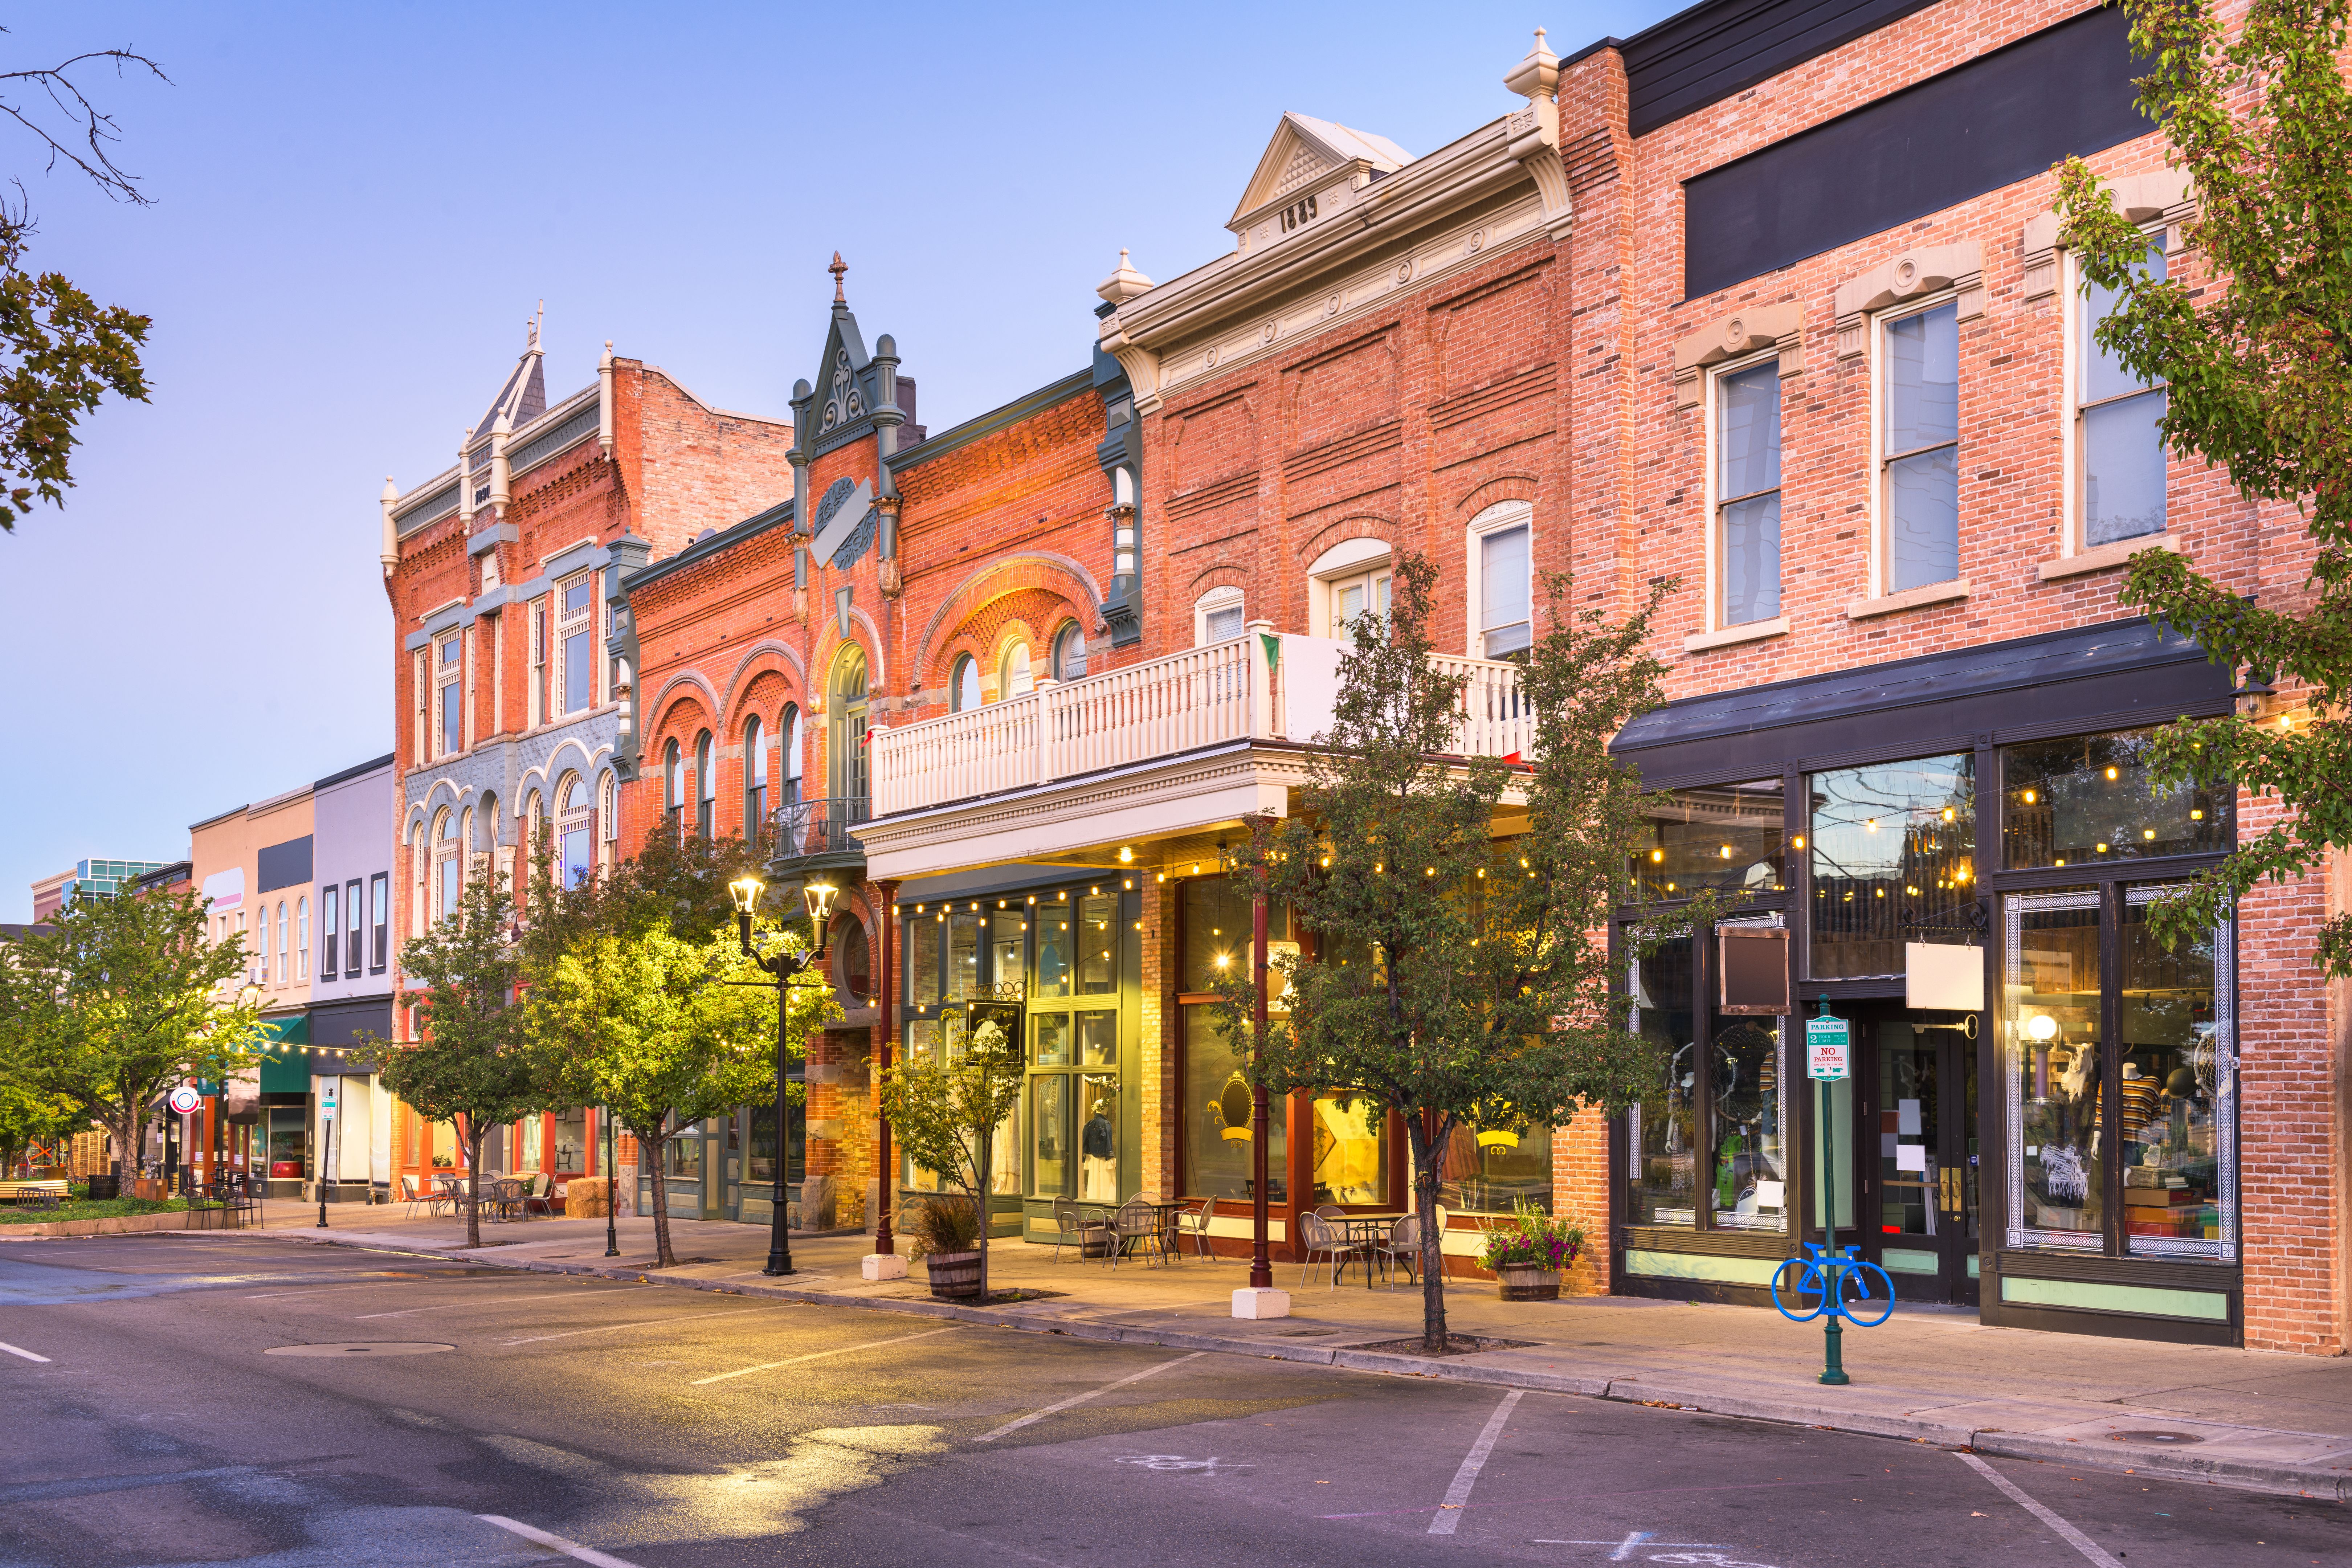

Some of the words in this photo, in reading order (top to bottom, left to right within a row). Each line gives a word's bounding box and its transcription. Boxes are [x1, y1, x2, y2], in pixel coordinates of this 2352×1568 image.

[1280, 195, 1318, 233] 1889
[1810, 1035, 1817, 1043] 2
[1801, 1273, 1810, 1287] provo
